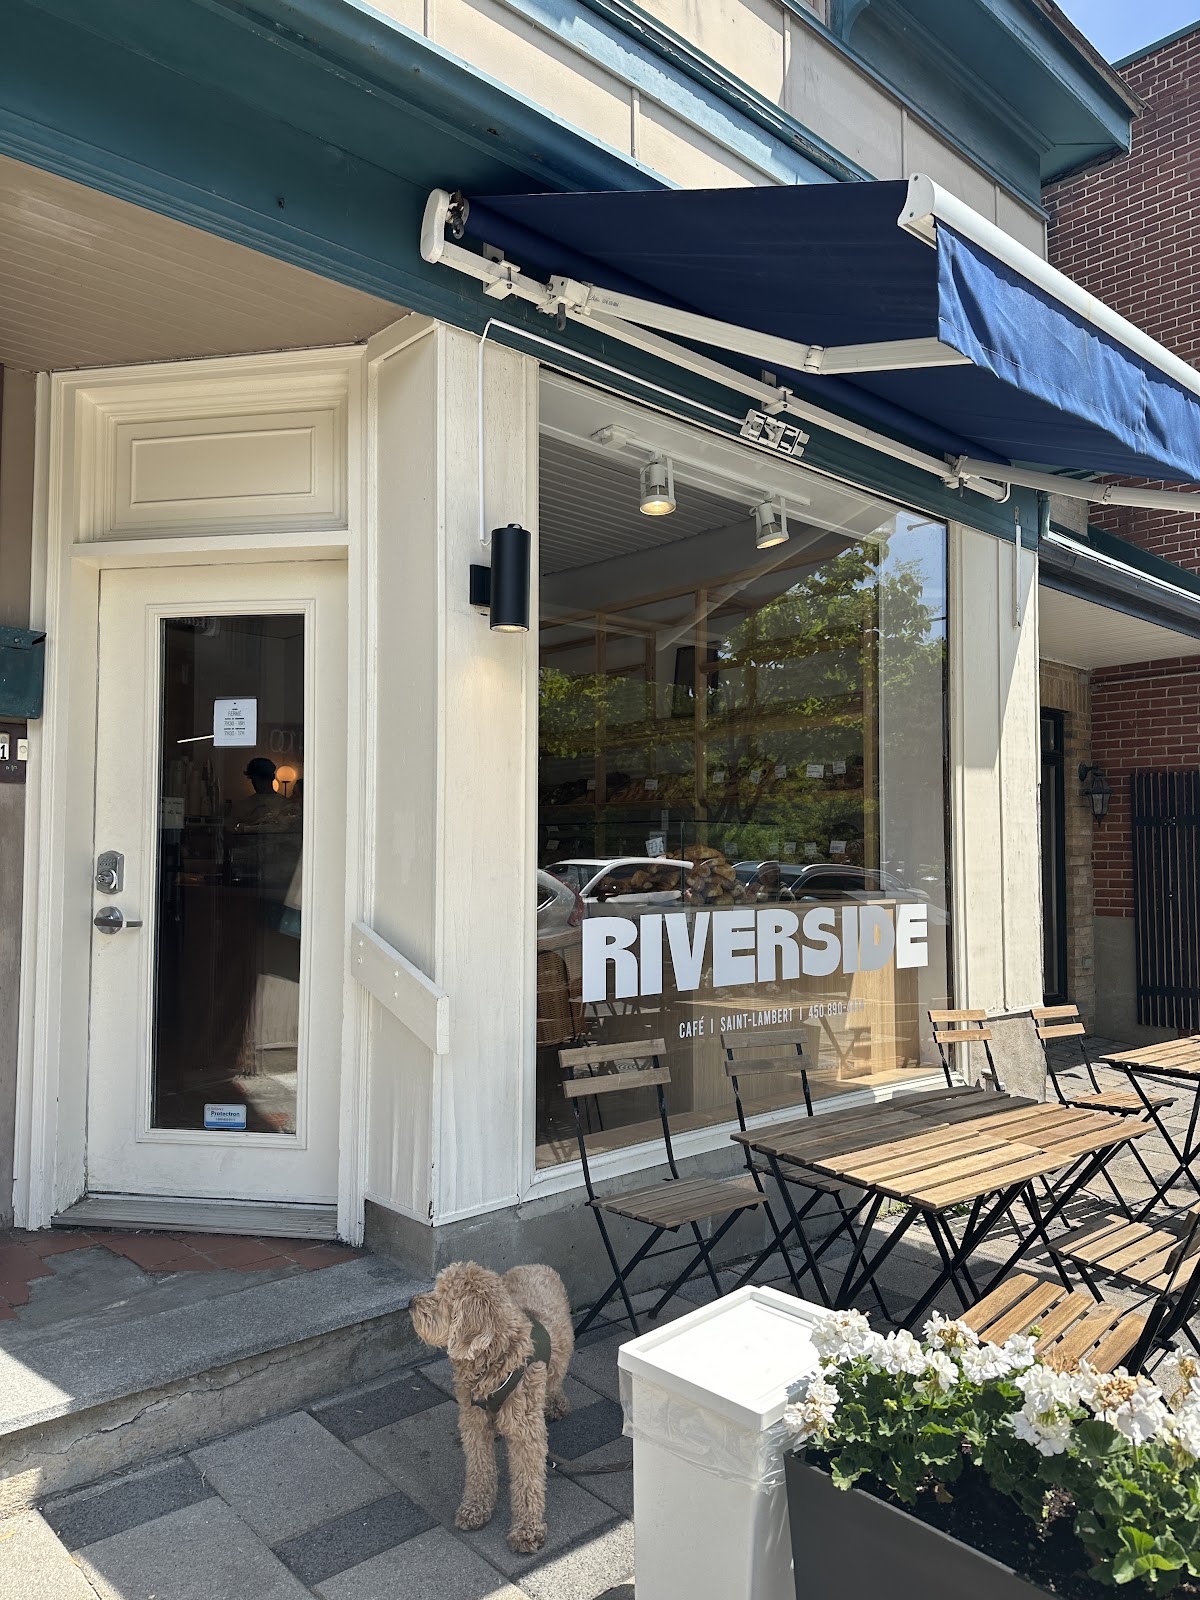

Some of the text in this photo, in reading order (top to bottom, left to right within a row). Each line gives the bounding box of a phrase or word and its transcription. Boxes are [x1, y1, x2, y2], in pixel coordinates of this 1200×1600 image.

[582, 903, 929, 1003] RIVERSIDE
[679, 1016, 704, 1039] CAFÉ
[720, 1007, 793, 1032] SAINT-LAMBERT
[808, 1003, 824, 1019] 450
